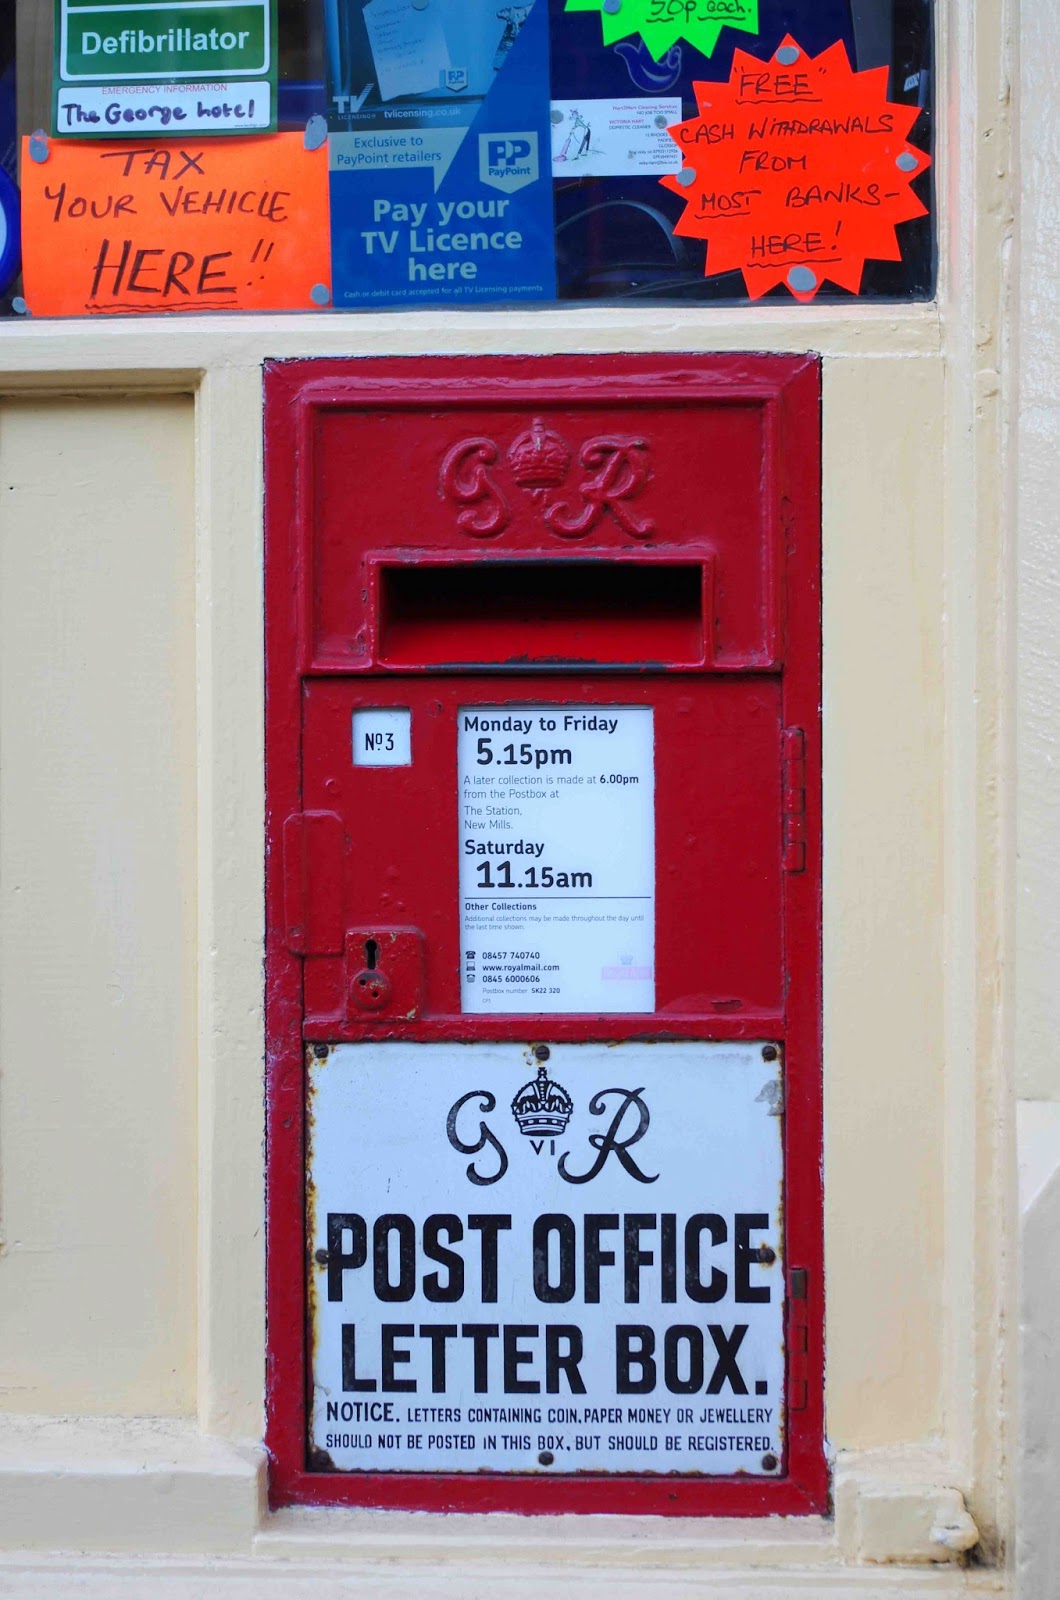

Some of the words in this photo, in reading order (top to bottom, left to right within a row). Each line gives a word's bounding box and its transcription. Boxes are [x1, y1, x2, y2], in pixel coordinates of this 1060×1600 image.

[81, 27, 250, 55] Defibrillator
[102, 85, 161, 95] EMERGENCY
[163, 83, 228, 94] INFORMATION
[332, 83, 375, 113] TV
[61, 103, 101, 126] The
[104, 103, 187, 125] George
[196, 99, 255, 119] hotel
[383, 107, 461, 119] tvlicensing.co.uk
[354, 137, 407, 149] Exclusive
[410, 136, 423, 146] to
[680, 129, 734, 144] CASH
[100, 149, 204, 180] TAX
[336, 153, 389, 167] PayPoint
[392, 151, 442, 162] retailers
[739, 150, 807, 174] FROM
[488, 167, 531, 178] PayPoint
[44, 182, 137, 222] YOUR
[160, 186, 290, 223] VEHICLE
[701, 190, 761, 211] MOST
[373, 199, 428, 226] Pay
[437, 199, 510, 226] your
[360, 230, 399, 254] TV
[409, 227, 523, 252] Licence
[751, 221, 842, 259] HERE!
[408, 256, 478, 281] here
[344, 291, 360, 299] Cash
[371, 289, 390, 298] debit
[391, 288, 407, 297] card
[408, 287, 440, 298] accepted
[441, 287, 452, 295] for
[453, 287, 463, 296] all
[464, 286, 474, 294] TV
[475, 284, 508, 296] Licensing
[509, 283, 543, 295] payments
[464, 716, 533, 735] Monday
[539, 718, 556, 731] to
[564, 716, 618, 734] Friday
[476, 738, 572, 769] 5.15pm
[463, 776, 471, 785] A
[473, 775, 494, 785] later
[498, 774, 542, 785] collection
[545, 775, 553, 785] is
[557, 774, 584, 785] made
[586, 775, 597, 785] at
[599, 774, 639, 786] 6.00pm
[463, 789, 487, 798] from
[490, 789, 505, 798] the
[509, 789, 546, 798] Postbox
[549, 789, 559, 798] at
[464, 806, 482, 816] The
[486, 805, 523, 816] Station,
[464, 820, 485, 830] New
[489, 820, 513, 830] Mills.
[464, 839, 544, 858] Saturday
[476, 860, 592, 888] 11.15am
[465, 902, 488, 911] Other
[491, 902, 537, 911] Collections
[571, 914, 605, 922] throughout
[617, 914, 629, 922] day
[482, 951, 507, 960] 08457
[510, 951, 541, 960] 740740
[482, 964, 560, 972] www.royalmail.com
[482, 975, 503, 983] 0845
[505, 975, 541, 983] 6000606
[446, 1090, 508, 1186] G
[557, 1087, 660, 1184] R
[327, 1213, 512, 1303] POST
[533, 1213, 771, 1304] OFFICE
[342, 1324, 586, 1394] LETTER
[616, 1324, 767, 1395] BOX.
[326, 1402, 400, 1422] NOTICE.
[407, 1408, 461, 1422] LETTERS
[468, 1408, 541, 1423] CONTAINING
[628, 1408, 671, 1423] MONEY
[676, 1408, 694, 1423] OR
[699, 1408, 773, 1423] JEWELLERY
[326, 1434, 372, 1448] SHOULD
[378, 1434, 402, 1449] NOT
[407, 1434, 423, 1449] BE
[428, 1434, 475, 1449] POSTED
[483, 1436, 497, 1449] IN
[501, 1436, 531, 1449] THIS
[575, 1435, 601, 1450] BUT
[608, 1435, 658, 1450] SHOULD
[665, 1435, 682, 1450] BE
[688, 1436, 774, 1451] REGISTERED.
